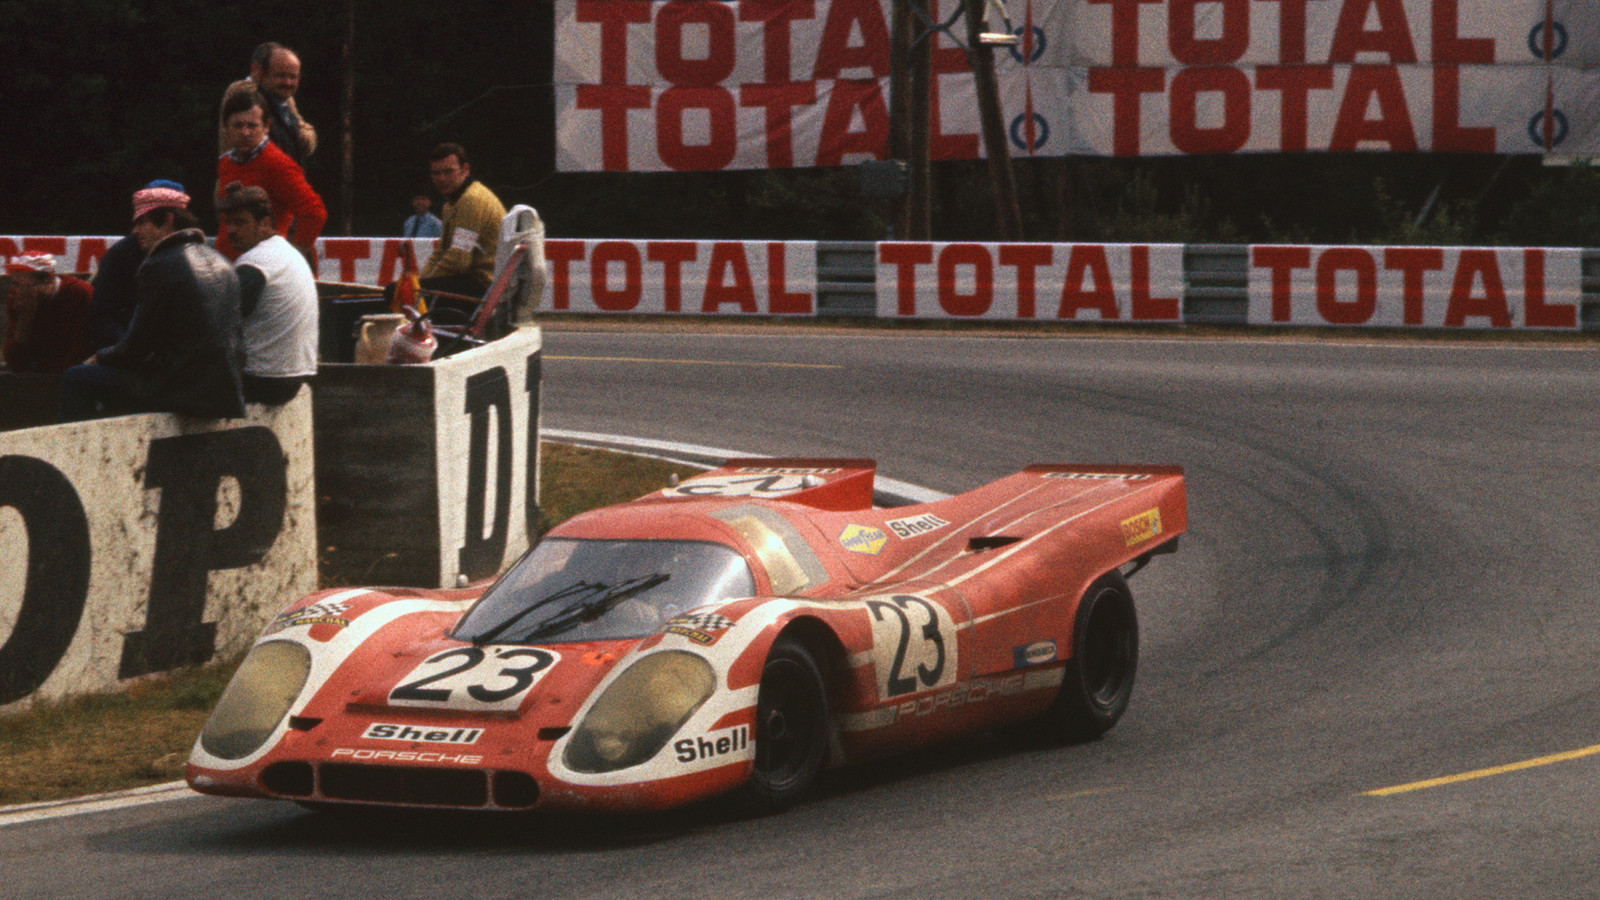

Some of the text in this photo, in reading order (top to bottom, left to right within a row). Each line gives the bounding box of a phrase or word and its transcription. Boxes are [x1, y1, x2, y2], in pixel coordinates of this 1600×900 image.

[575, 0, 975, 88] TOTAL
[576, 79, 979, 172] TOTAL
[1088, 64, 1497, 157] TOTAL
[544, 241, 813, 314] TOTAL
[879, 244, 1179, 320] TOTAL
[1252, 246, 1577, 328] TOTAL
[889, 515, 947, 537] Shell
[389, 646, 555, 703] 23
[873, 595, 945, 696] 23
[896, 673, 1024, 719] PORSCHE
[330, 748, 484, 765] PORSCHE
[367, 724, 480, 744] Shell
[674, 726, 747, 763] Shell
